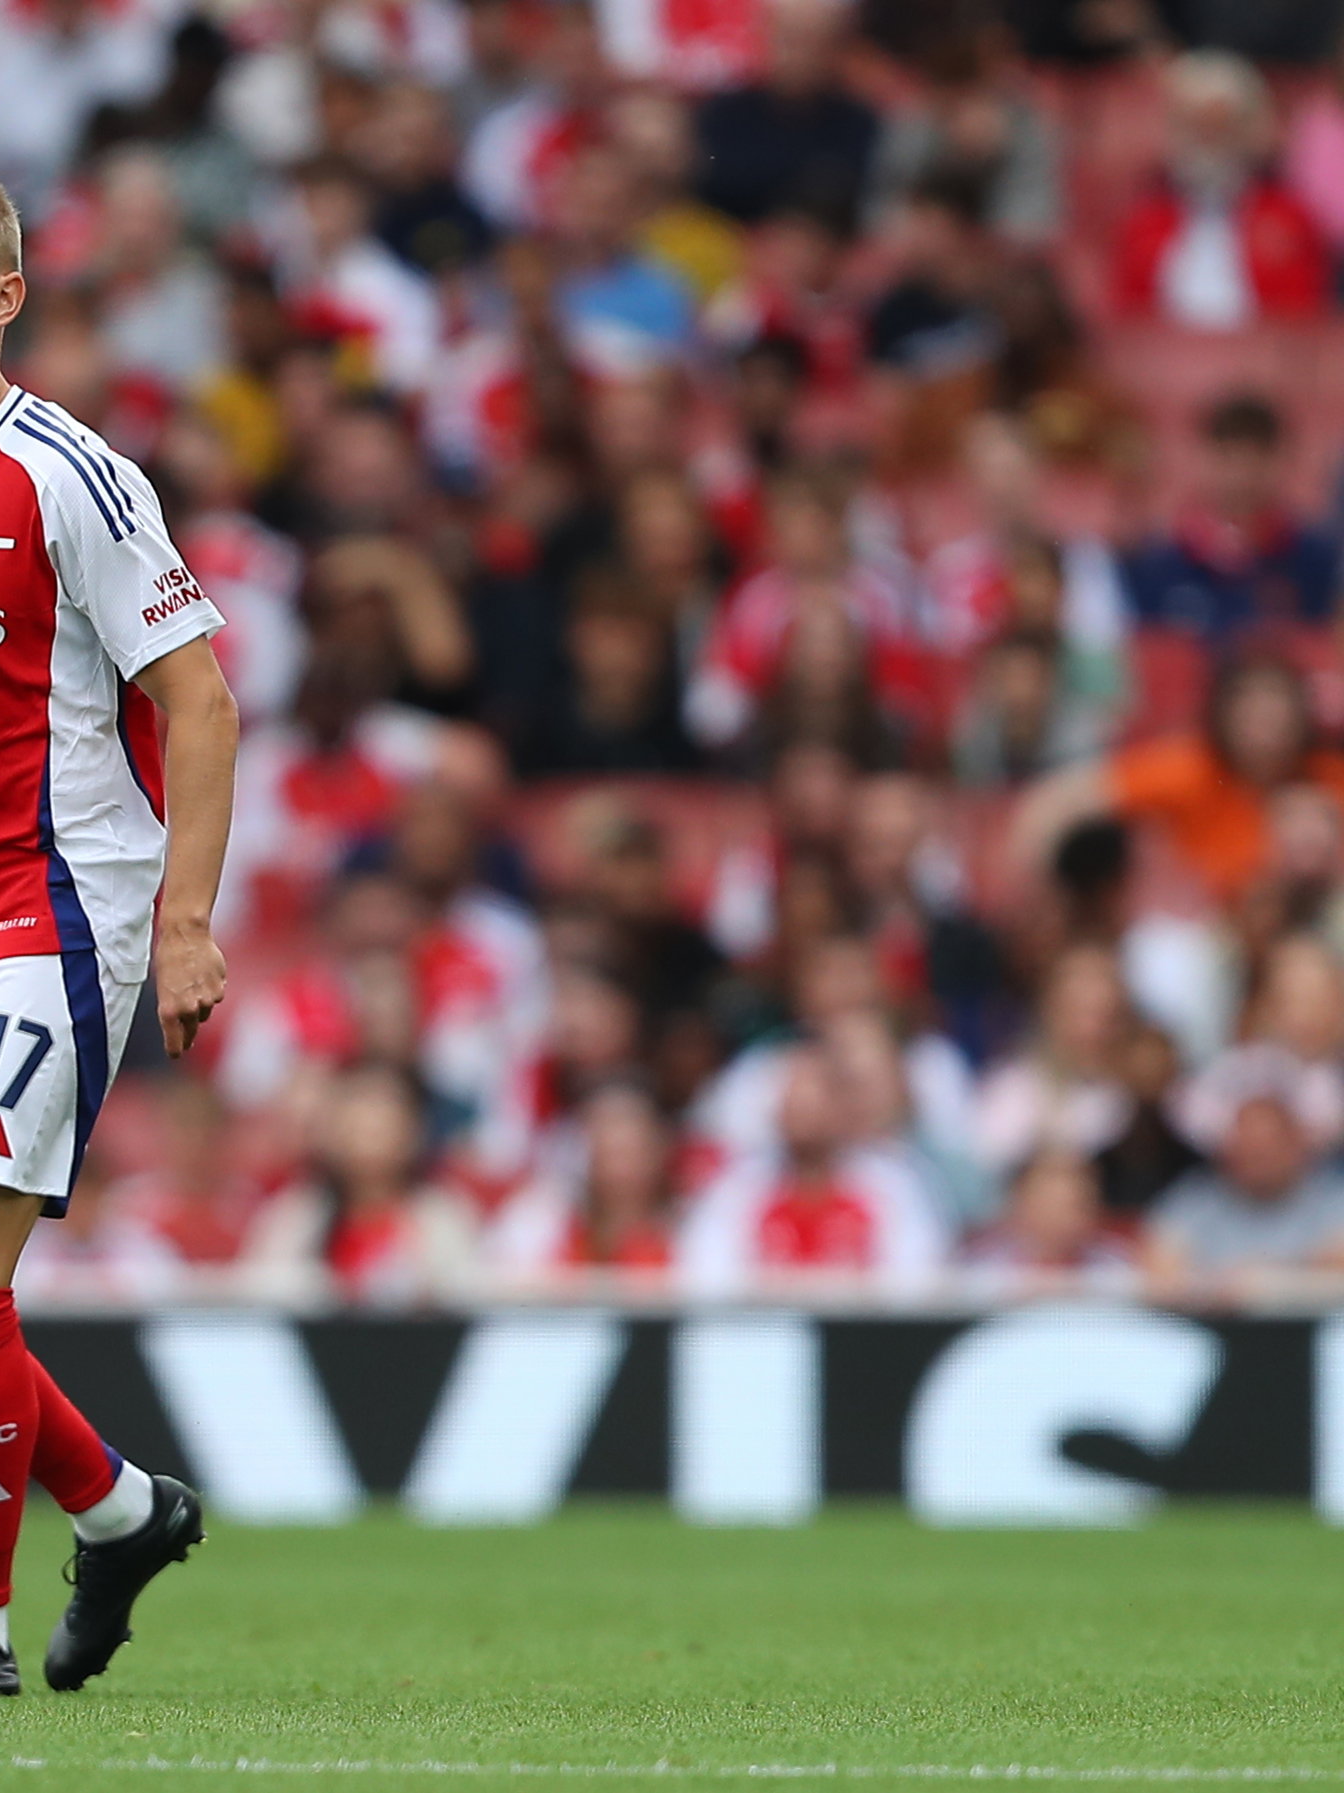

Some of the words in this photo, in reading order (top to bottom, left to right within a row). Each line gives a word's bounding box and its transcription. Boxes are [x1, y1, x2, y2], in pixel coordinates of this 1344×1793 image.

[153, 567, 191, 594] VISI
[141, 584, 203, 627] RWAN
[136, 1308, 1344, 1524] VIS
